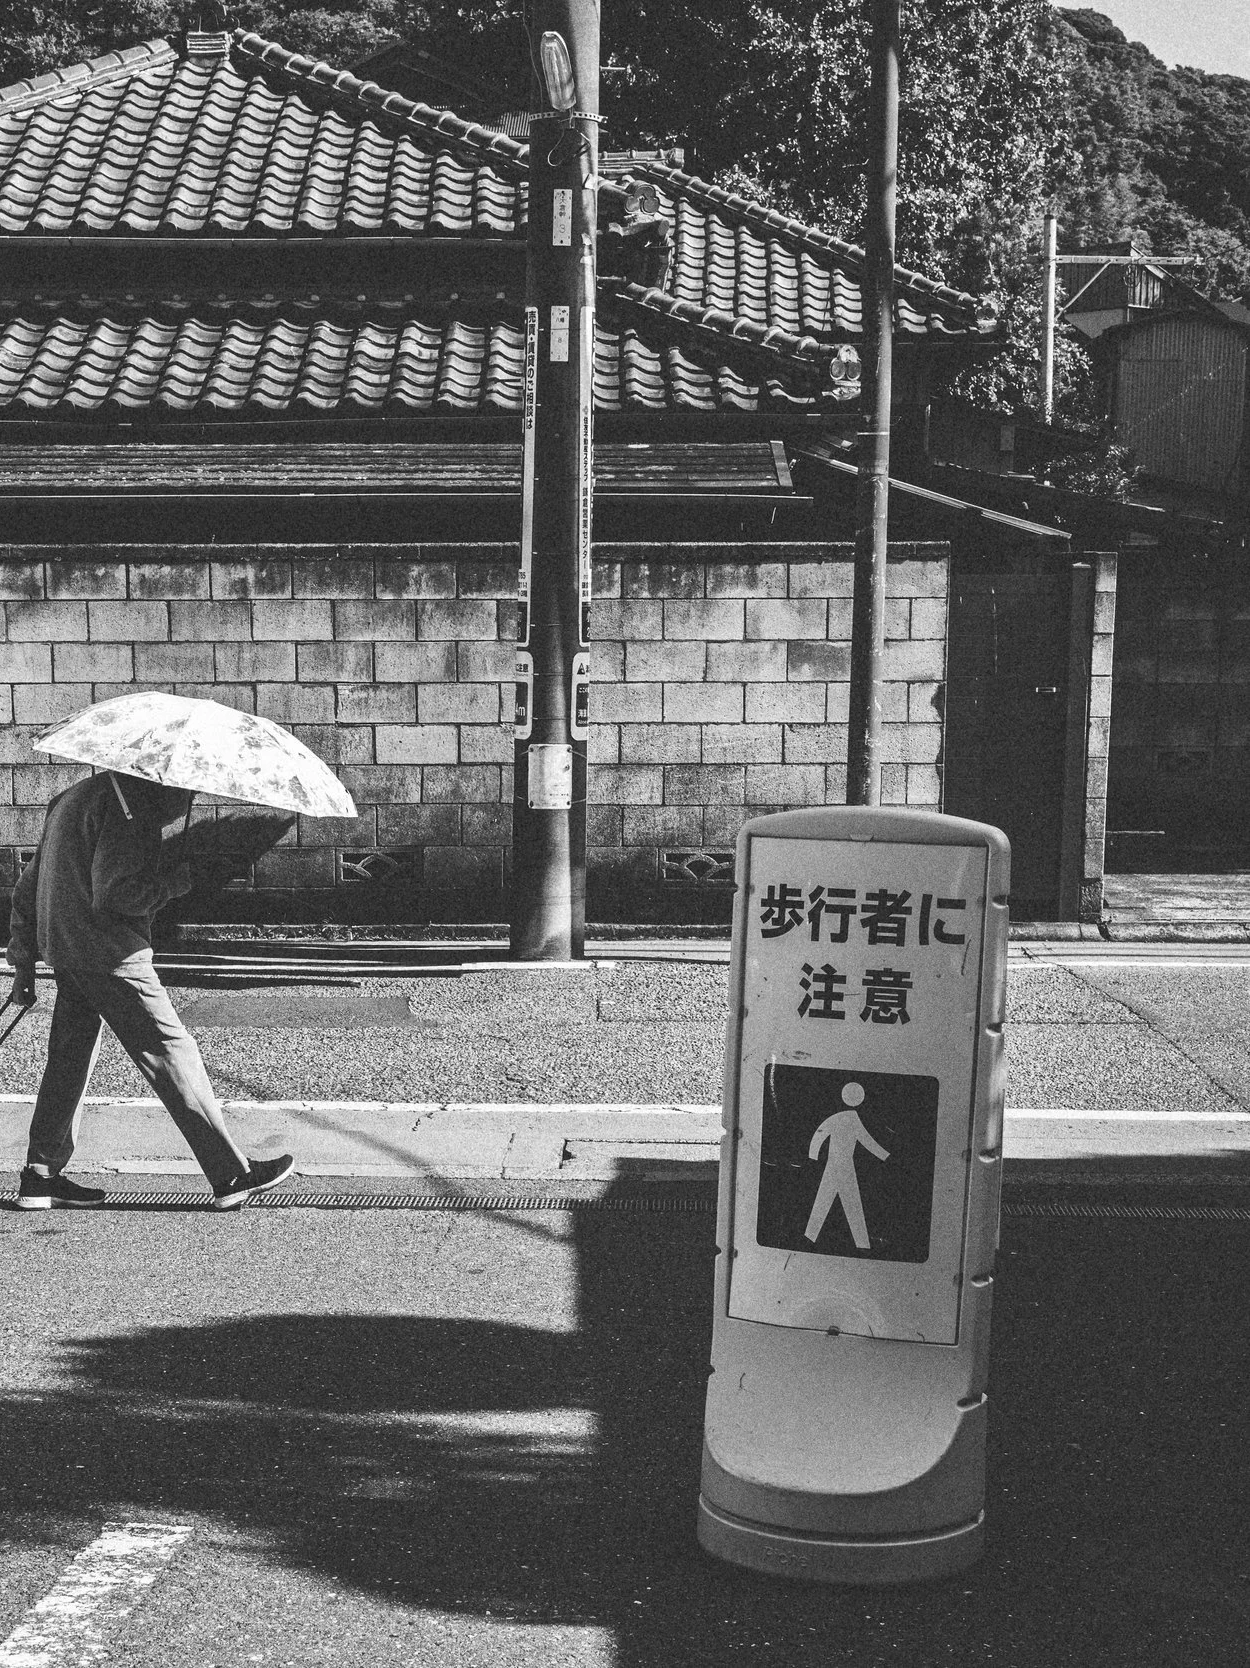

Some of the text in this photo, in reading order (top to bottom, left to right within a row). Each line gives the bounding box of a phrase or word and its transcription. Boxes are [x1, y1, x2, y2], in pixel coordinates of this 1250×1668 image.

[525, 310, 537, 431] 売買・賃貸のご相談は
[759, 883, 967, 948] 歩行者に
[797, 962, 913, 1025] 注意
